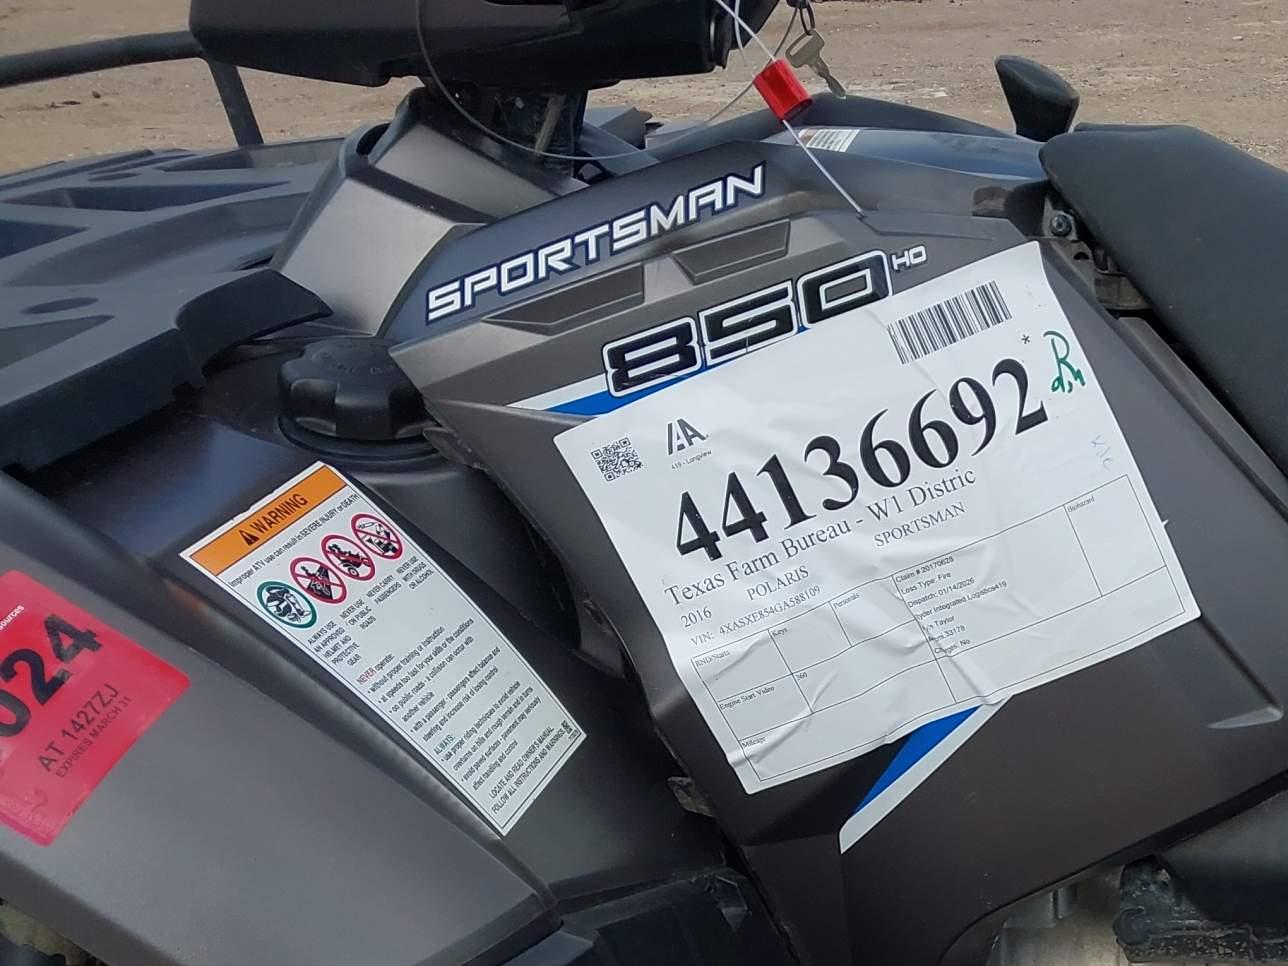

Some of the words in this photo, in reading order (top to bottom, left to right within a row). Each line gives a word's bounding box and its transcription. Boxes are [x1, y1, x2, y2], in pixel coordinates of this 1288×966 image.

[427, 163, 766, 324] SPORTSMAN
[602, 250, 892, 397] 850
[892, 245, 927, 272] HO
[674, 357, 1048, 563] 44136692
[335, 504, 344, 512] or
[340, 492, 360, 508] DEATH
[249, 491, 309, 536] WARNING
[318, 507, 339, 524] INJURY
[294, 533, 304, 541] in
[298, 519, 323, 538] SEVERE
[663, 568, 726, 606] Texas
[725, 546, 780, 581] Farm
[779, 516, 853, 558] Bureau
[865, 494, 904, 523] W1
[906, 463, 978, 507] Distric
[272, 547, 285, 557] can
[280, 536, 298, 551] result
[251, 559, 267, 572] ATV
[262, 553, 276, 564] use
[679, 606, 714, 628] 2016
[743, 564, 812, 601] POLARIS
[872, 501, 967, 547] SPORTSMAN
[227, 567, 256, 589] Improper
[900, 583, 917, 595] Loss
[917, 576, 937, 589] Type:
[936, 570, 952, 581] Fire
[906, 591, 938, 608] Dispatch:
[937, 576, 975, 596] 01/14/2026
[689, 630, 715, 647] VIN:
[38, 741, 65, 772] AT
[61, 683, 119, 740] 1427ZJ
[55, 738, 93, 778] EXPIRES
[89, 706, 122, 738] MARCH
